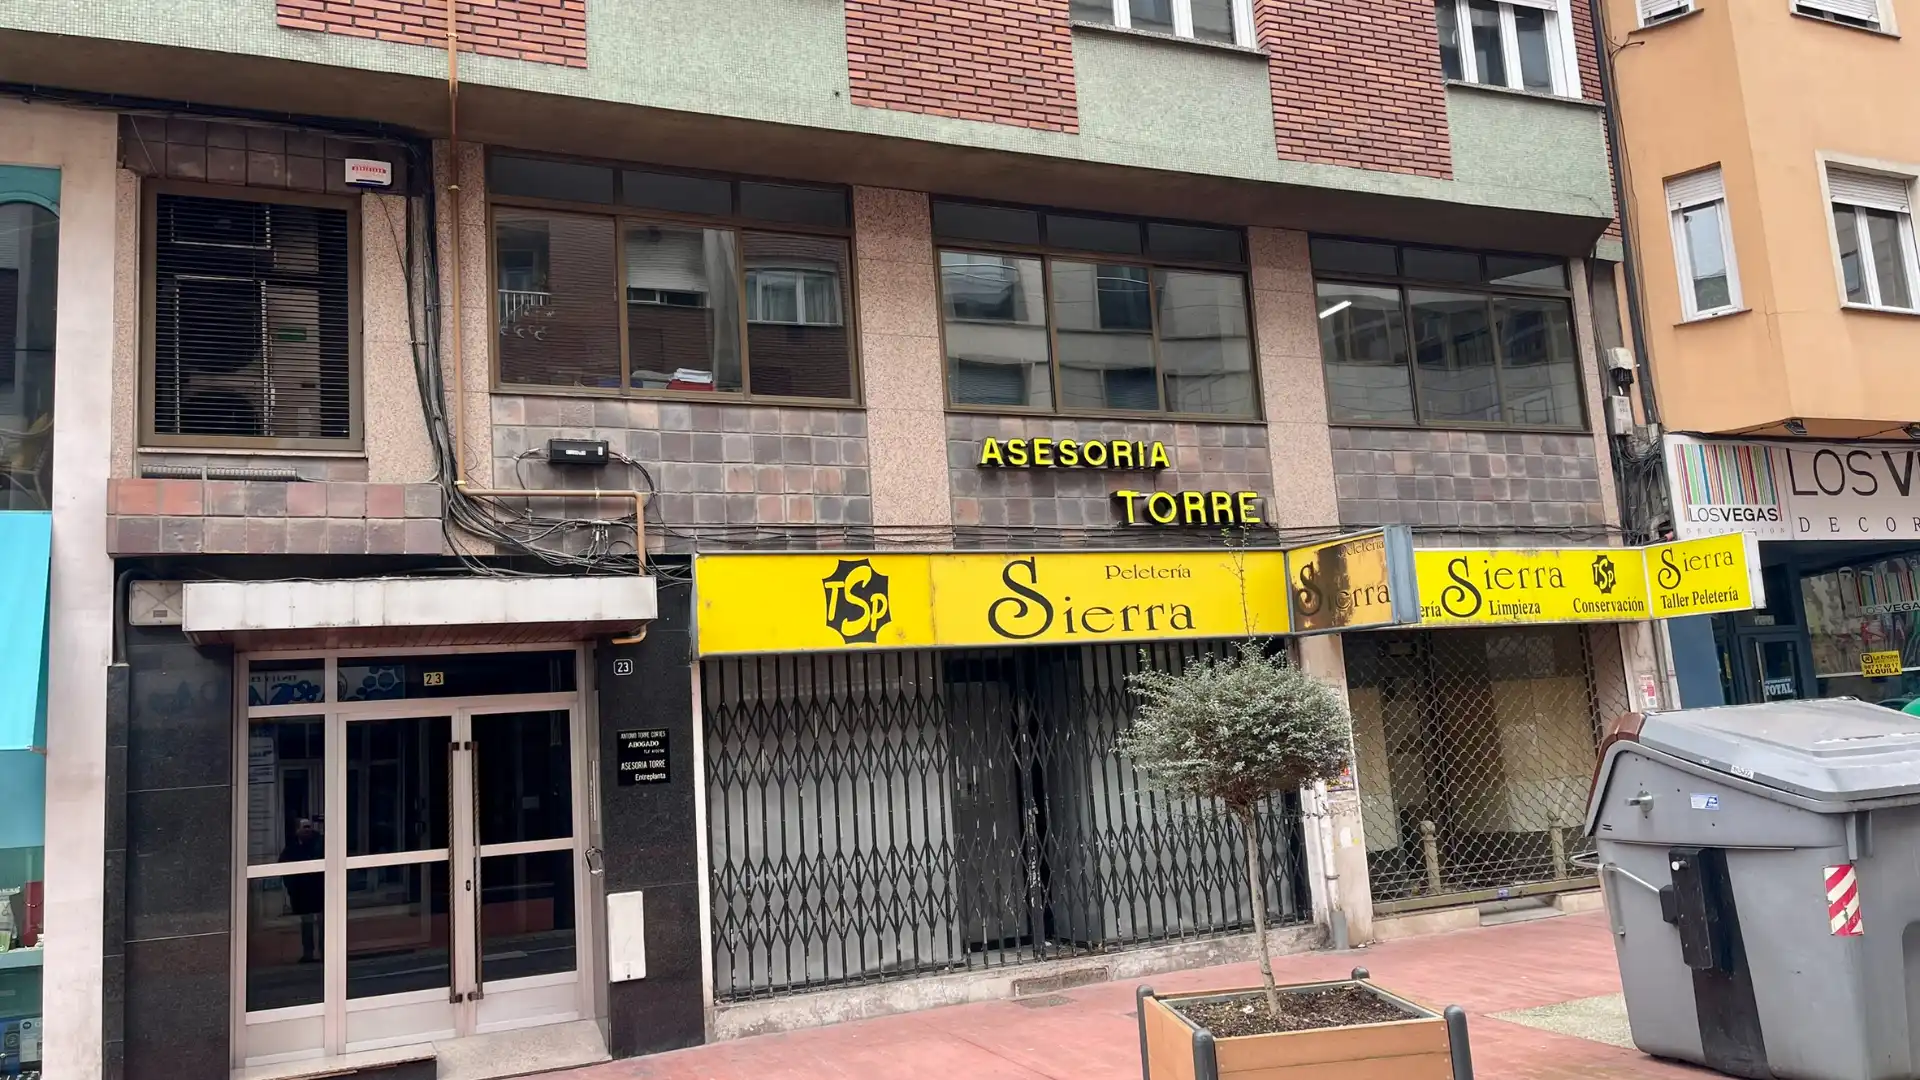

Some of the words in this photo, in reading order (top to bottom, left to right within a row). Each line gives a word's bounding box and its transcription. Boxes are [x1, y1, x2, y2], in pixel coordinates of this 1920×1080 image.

[979, 437, 1170, 468] ASESORIA
[1786, 448, 1920, 497] LOSV
[1116, 490, 1261, 523] TORRE
[1688, 506, 1779, 522] LOSVEGAS
[1105, 564, 1191, 580] Peletería
[1657, 547, 1734, 590] Sierra
[1441, 555, 1566, 618] Sierra
[987, 556, 1197, 640] Sierra
[1573, 596, 1644, 614] Conservación
[1660, 593, 1690, 609] Taller
[1692, 586, 1739, 606] Peletería
[1488, 599, 1541, 619] Limpieza
[617, 662, 629, 673] 23
[425, 673, 442, 685] 23
[1764, 682, 1794, 696] TOTAL
[628, 740, 660, 748] ABOGADO
[621, 761, 648, 770] ASESORIA
[649, 759, 666, 768] TORRE
[635, 773, 667, 782] Entreplanta
